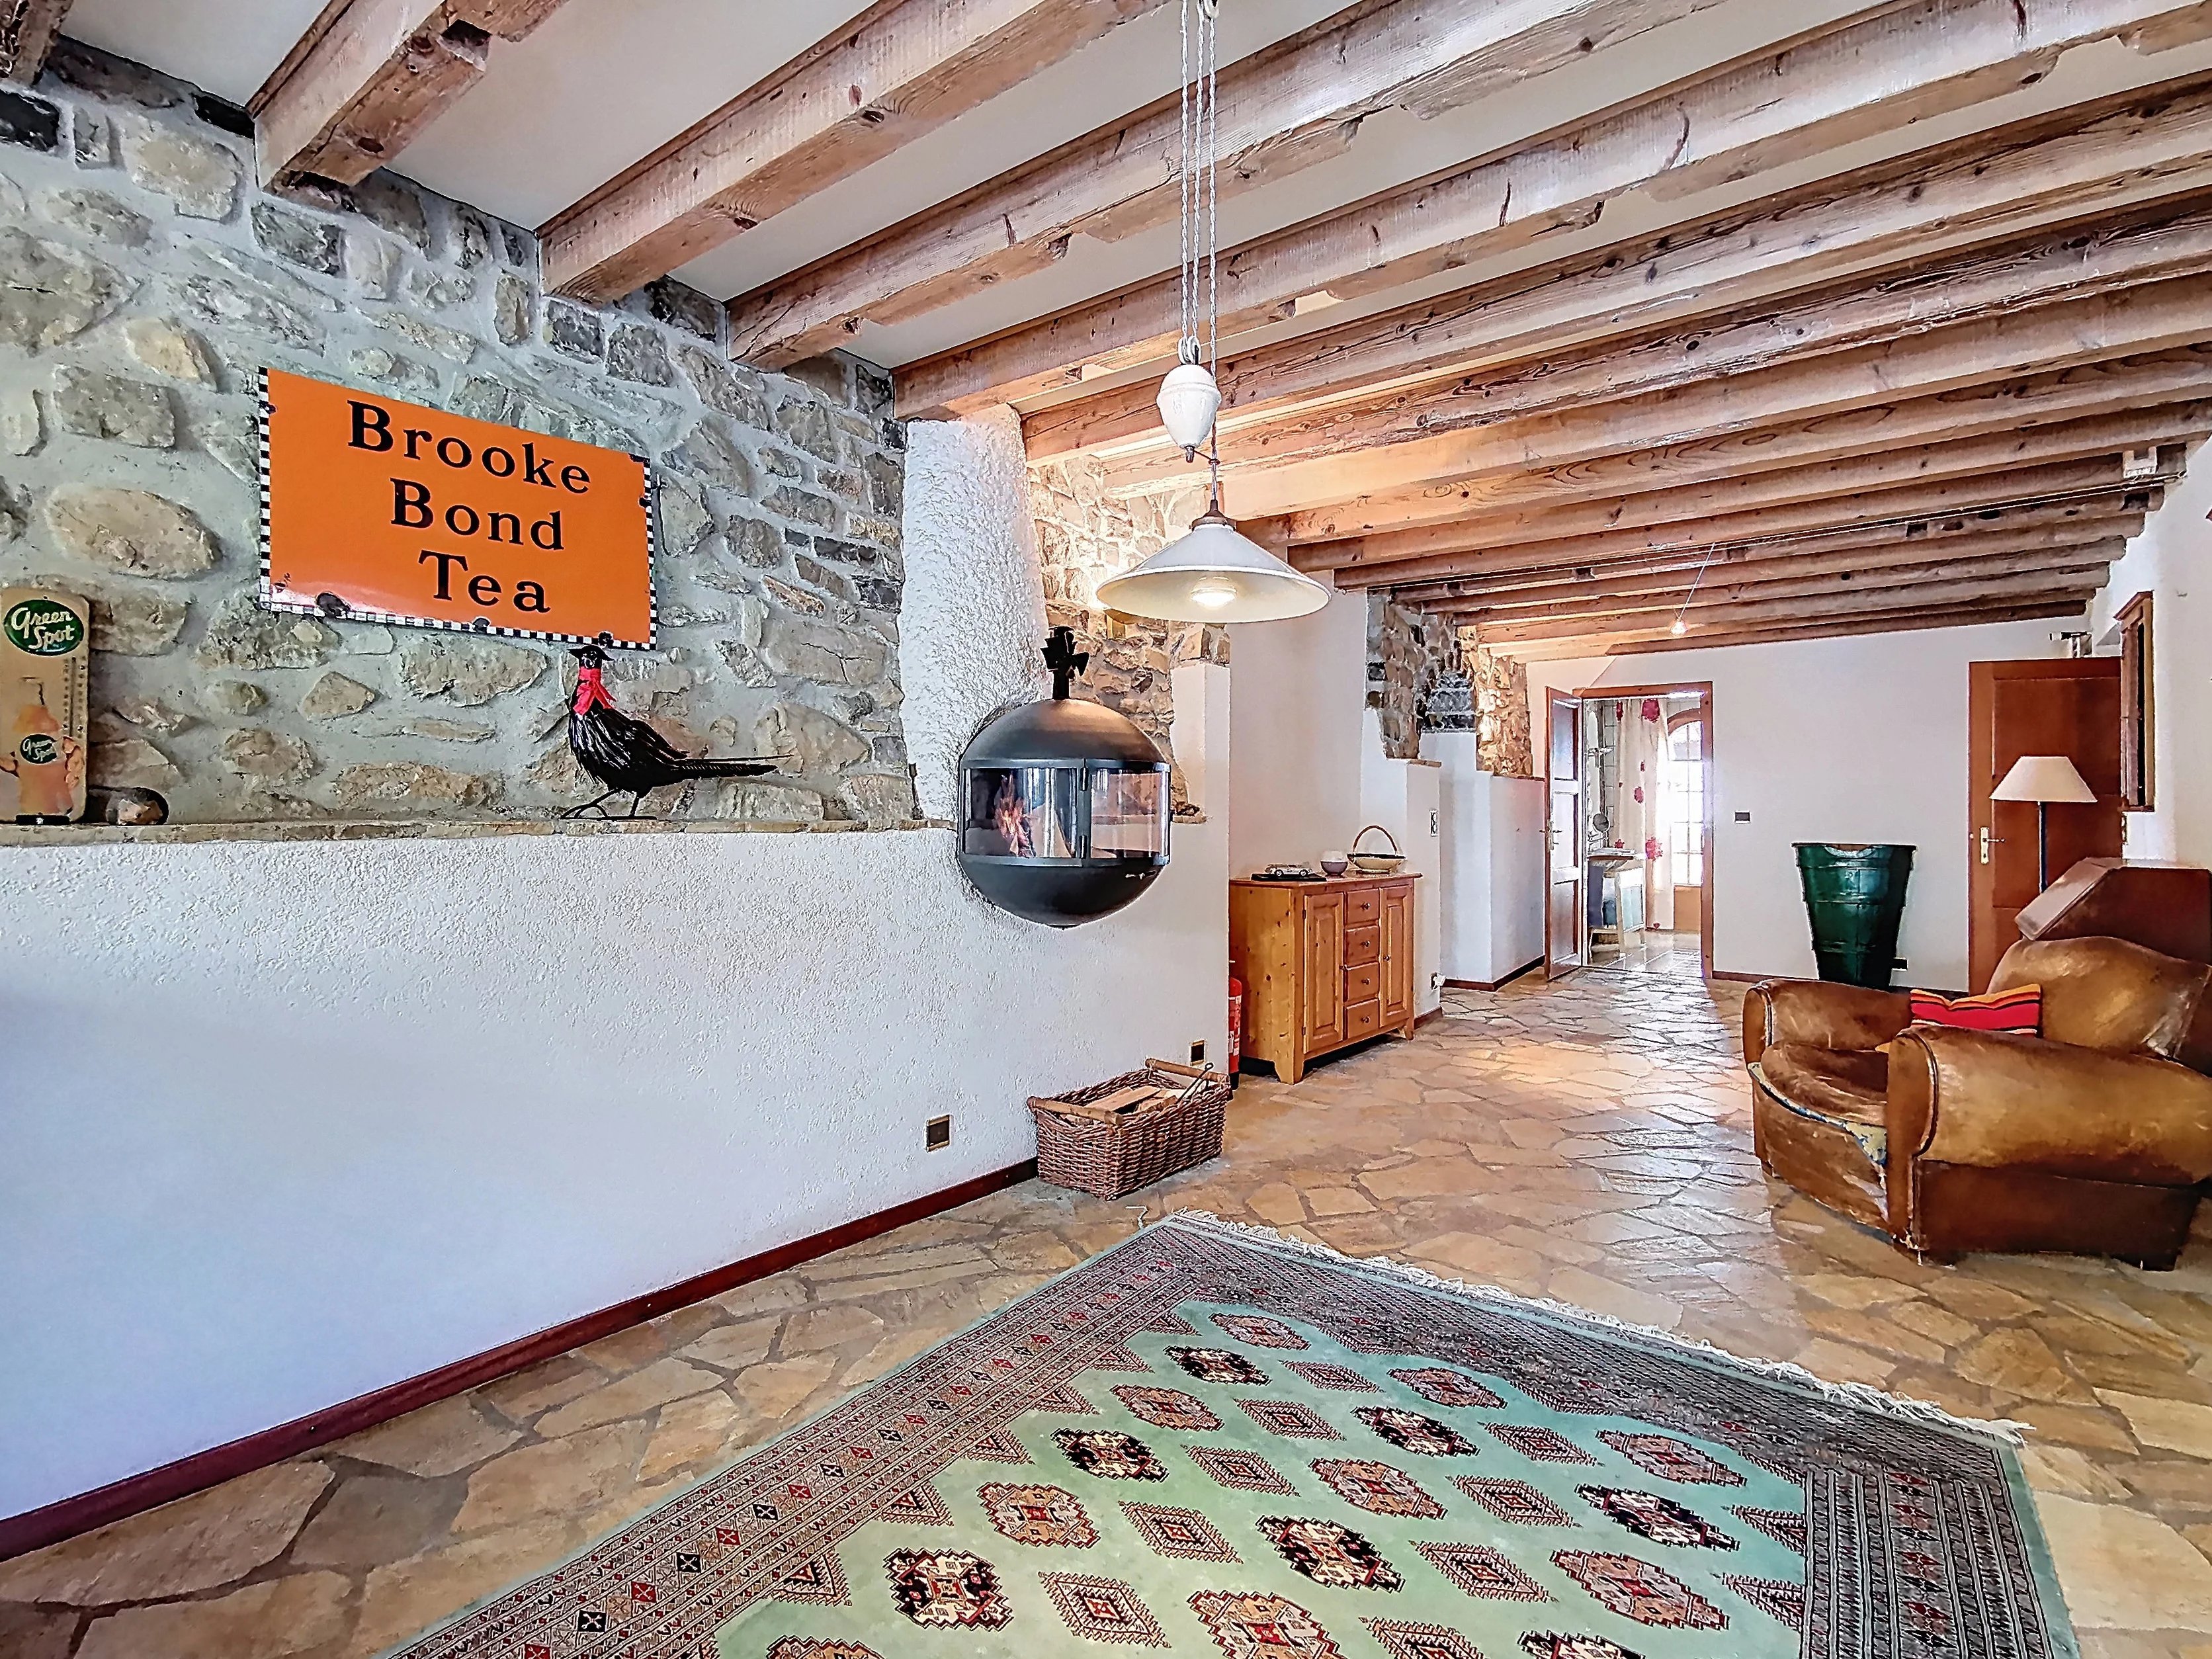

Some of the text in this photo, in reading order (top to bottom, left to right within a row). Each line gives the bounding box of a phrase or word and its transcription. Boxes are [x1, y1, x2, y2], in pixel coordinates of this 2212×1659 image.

[347, 400, 591, 494] Brooke
[390, 478, 565, 550] Bond
[418, 550, 551, 613] Tea
[11, 607, 73, 639] Green
[28, 625, 75, 651] Spot
